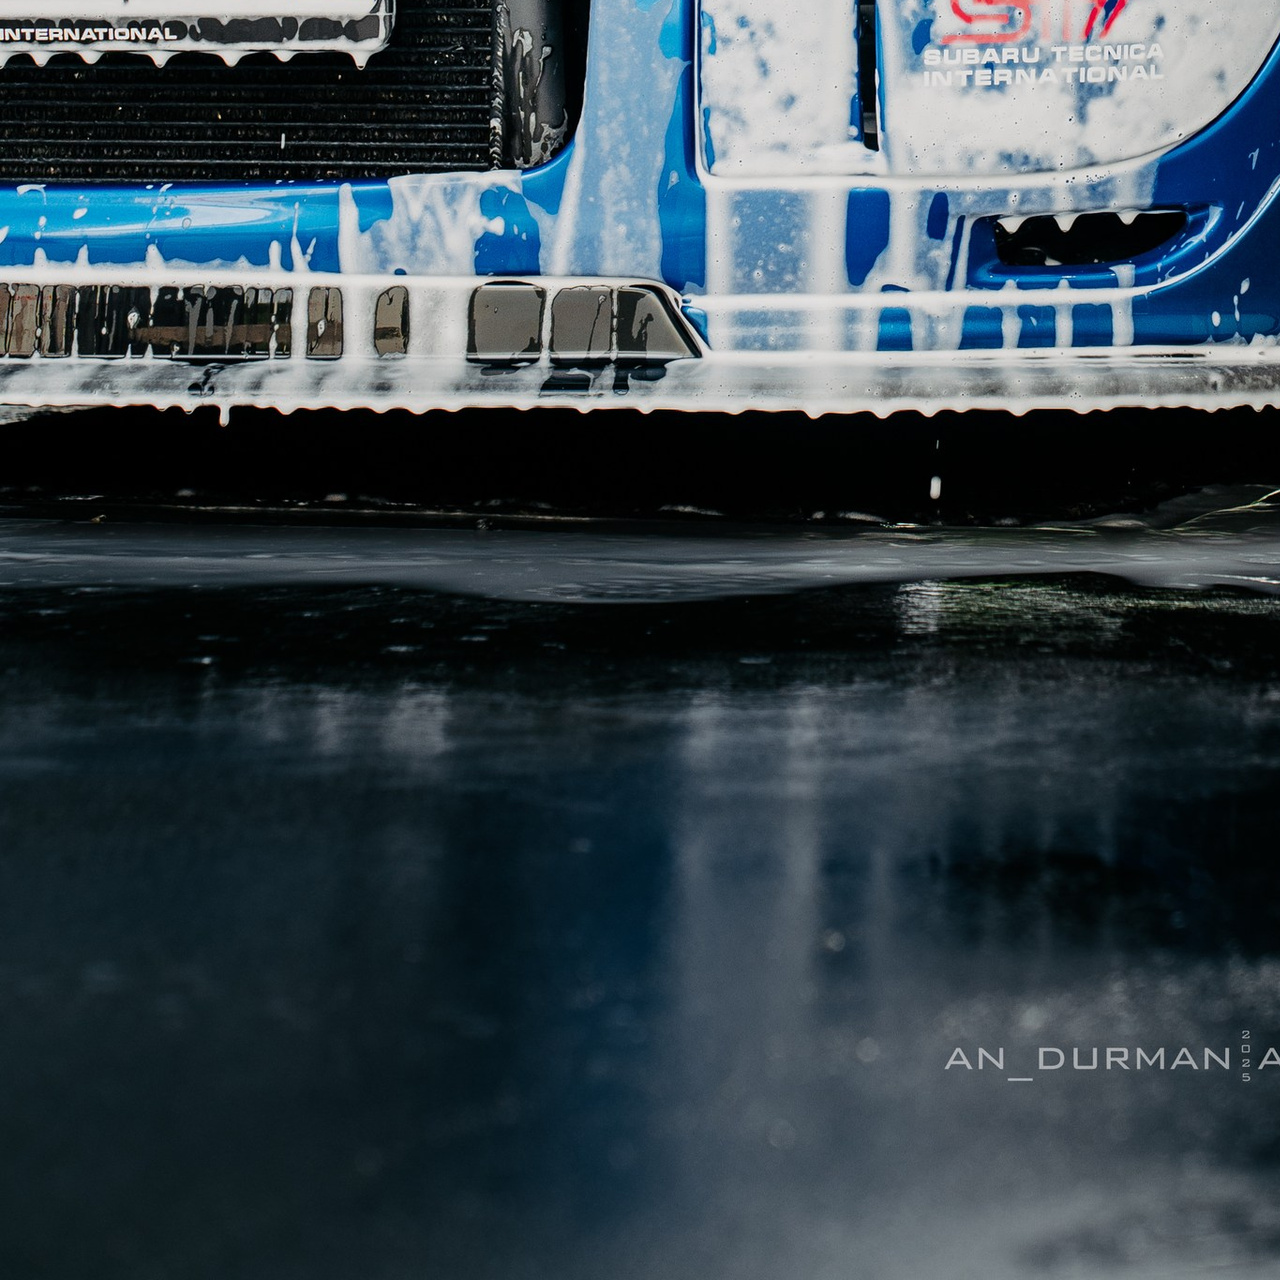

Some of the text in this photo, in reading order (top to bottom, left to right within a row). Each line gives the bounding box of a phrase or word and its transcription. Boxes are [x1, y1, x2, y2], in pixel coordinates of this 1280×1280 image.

[0, 28, 177, 40] INTERNATIONAL
[924, 43, 1164, 64] SUBARU TECNICA
[923, 64, 1164, 86] INTERNATIONAL
